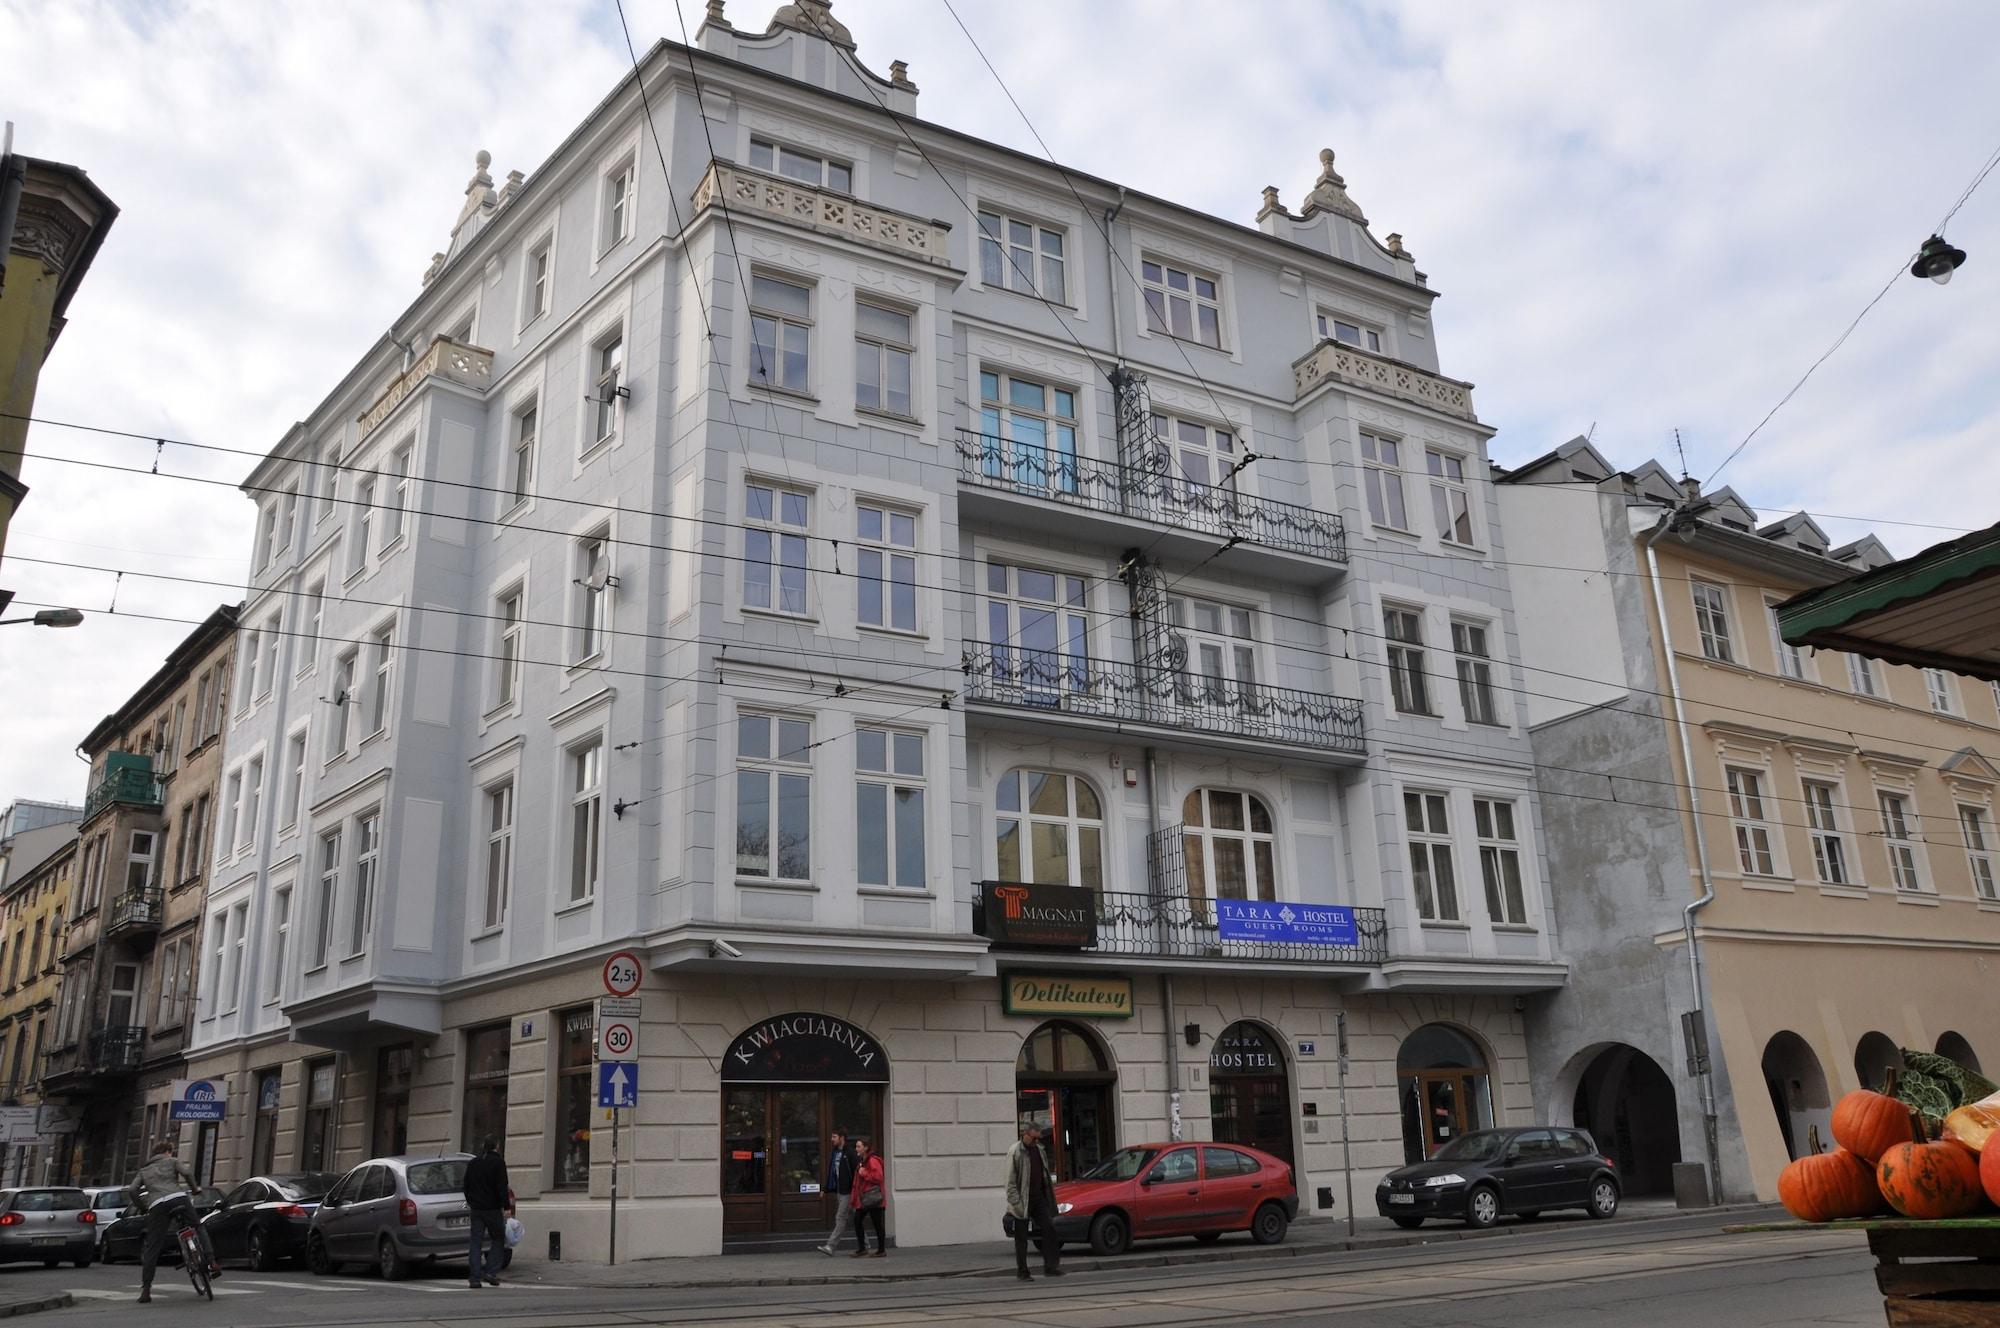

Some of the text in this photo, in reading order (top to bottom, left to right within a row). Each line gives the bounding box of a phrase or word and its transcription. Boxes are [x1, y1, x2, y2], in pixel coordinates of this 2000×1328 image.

[1023, 906, 1086, 922] MAGNAT
[1223, 905, 1349, 924] TARA HOSTEL
[1244, 921, 1333, 933] GUEST ROOMS
[611, 965, 636, 984] 2,5t
[1013, 980, 1126, 1008] Delikatesy
[610, 1032, 628, 1046] 30
[734, 1017, 875, 1069] KWIACIARNIA
[1223, 1038, 1262, 1047] TARA
[1210, 1053, 1277, 1067] HOSTEL
[195, 1090, 216, 1101] IRIS
